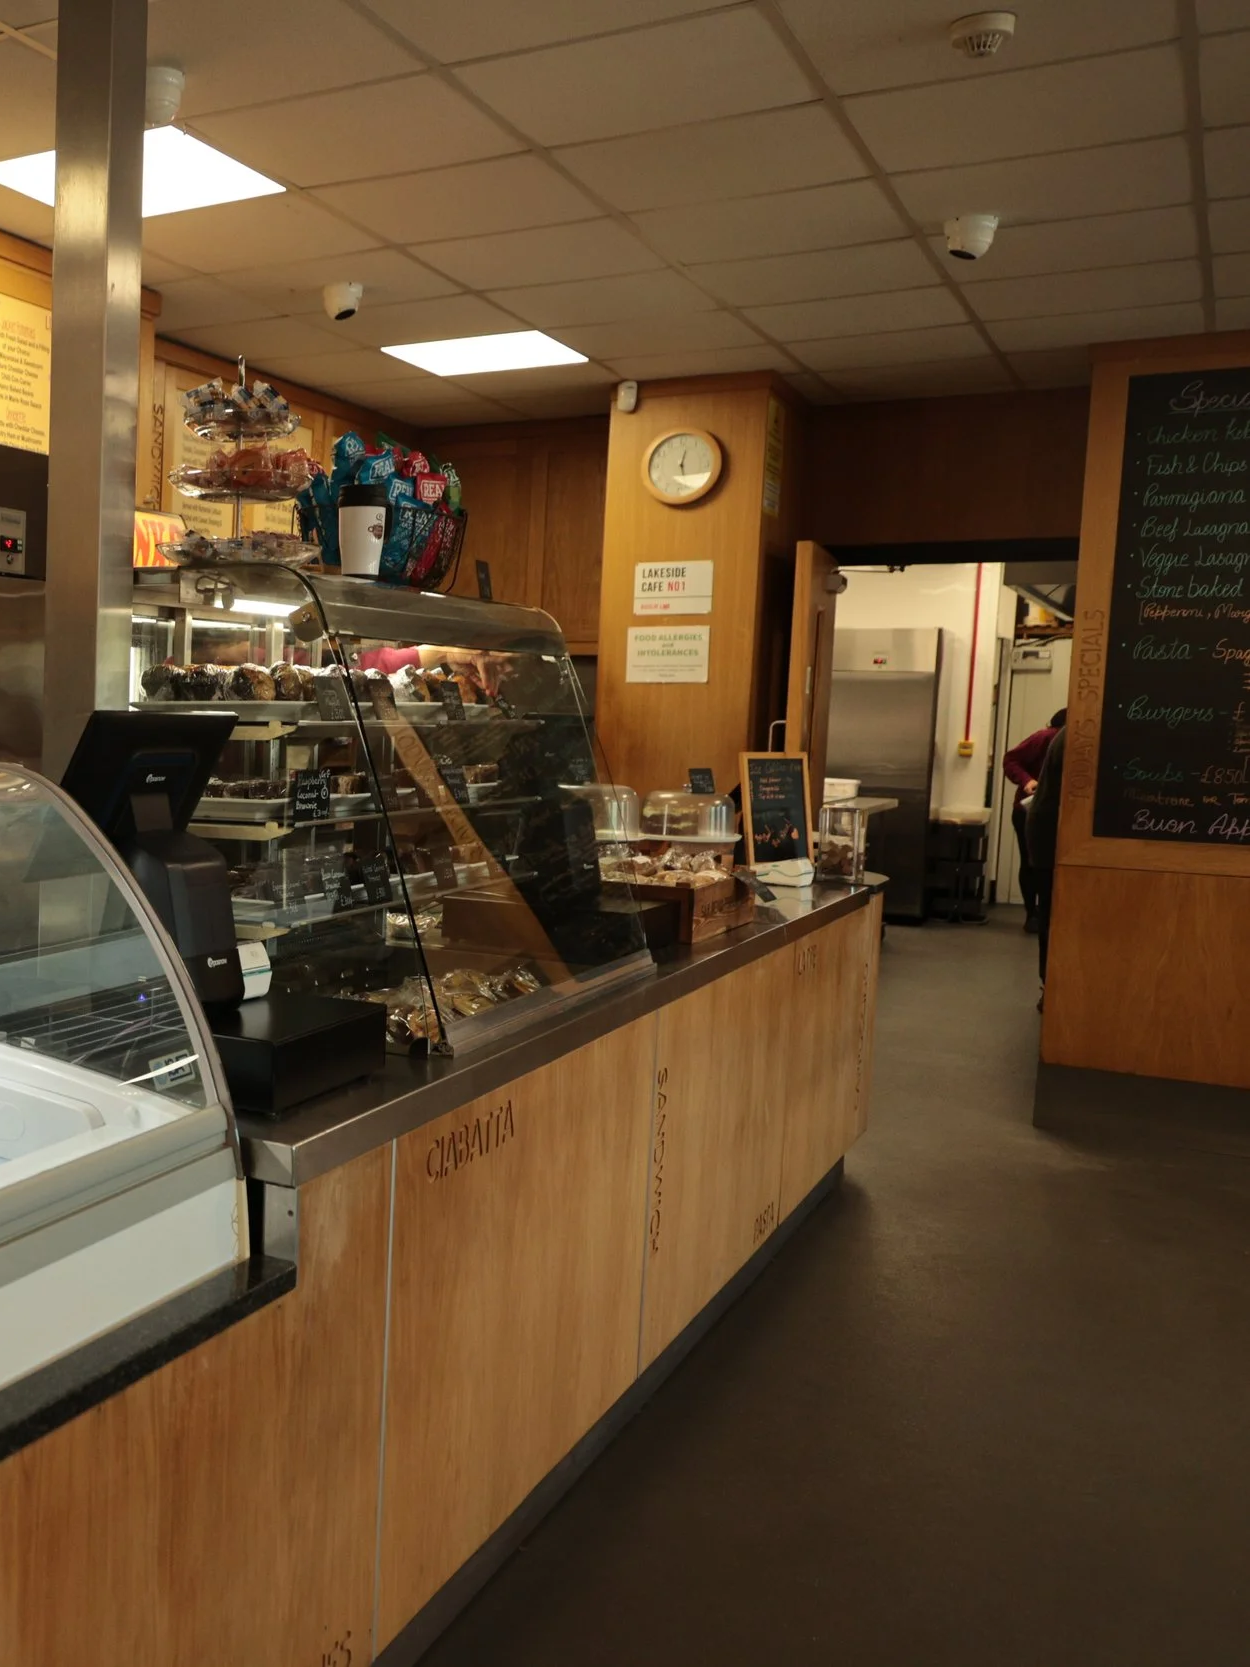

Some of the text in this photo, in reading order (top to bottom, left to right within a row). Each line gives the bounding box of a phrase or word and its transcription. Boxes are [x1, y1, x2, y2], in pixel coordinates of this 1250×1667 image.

[1147, 423, 1219, 444] Chicken
[1146, 451, 1248, 477] Fish & Chips
[1142, 483, 1247, 512] Parmigiana
[1140, 516, 1250, 543] Beef Lasagna
[1140, 543, 1190, 575] Veggie
[642, 567, 687, 579] LAKESIDE
[1136, 574, 1243, 598] Stone baked
[641, 581, 664, 592] CAFE
[667, 581, 680, 592] NO
[634, 633, 703, 642] FOOD ALLERGIES
[1133, 634, 1193, 660] Pasta
[637, 649, 699, 657] INTOLERANCES
[1078, 609, 1105, 704] SPECIALS
[1127, 694, 1214, 729] Burgers
[297, 789, 319, 799] Coconut
[1132, 808, 1198, 834] Buon
[426, 1100, 515, 1183] CIABATTA
[752, 1202, 775, 1245] PASTA
